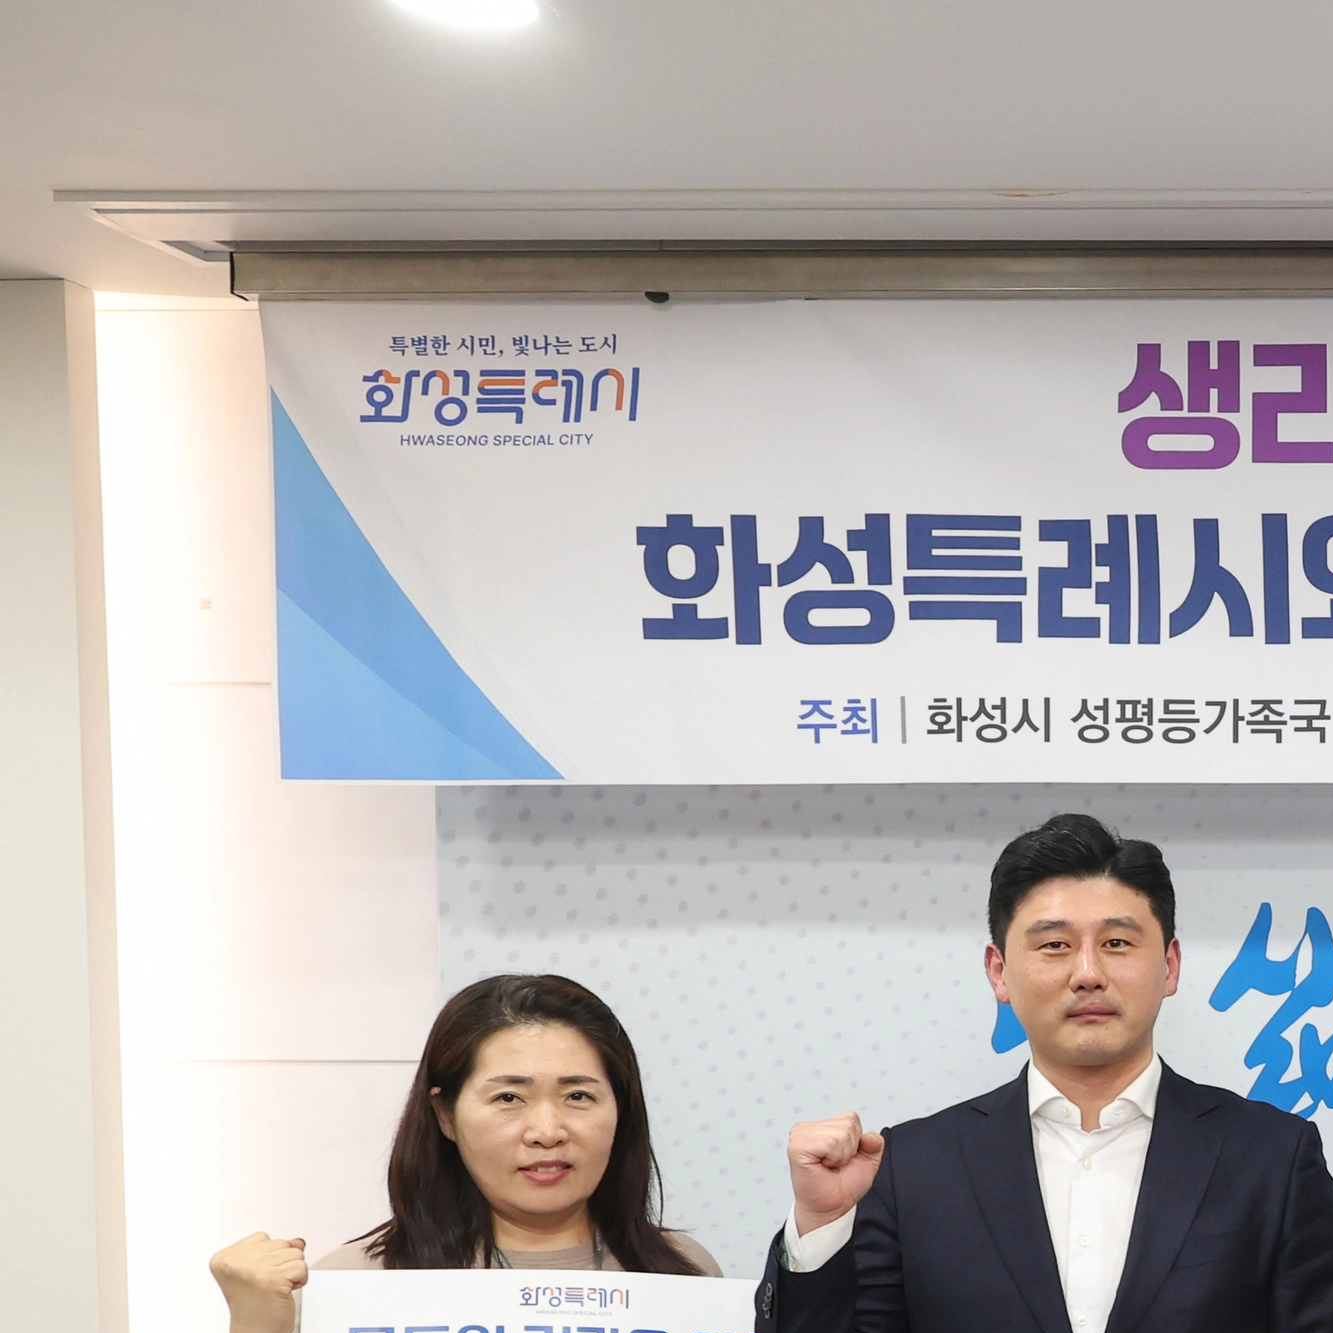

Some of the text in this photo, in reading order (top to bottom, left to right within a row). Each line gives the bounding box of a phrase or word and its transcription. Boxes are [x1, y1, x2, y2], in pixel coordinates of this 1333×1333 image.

[388, 334, 616, 358] 특별한 시민, 빛나는 도시
[360, 367, 640, 426] 화성특례시
[400, 433, 594, 446] HWASEONG SPECIAL CITY
[798, 699, 877, 743] 주최
[927, 697, 1050, 743] 화성시
[1071, 698, 1331, 744] 성평등가족국
